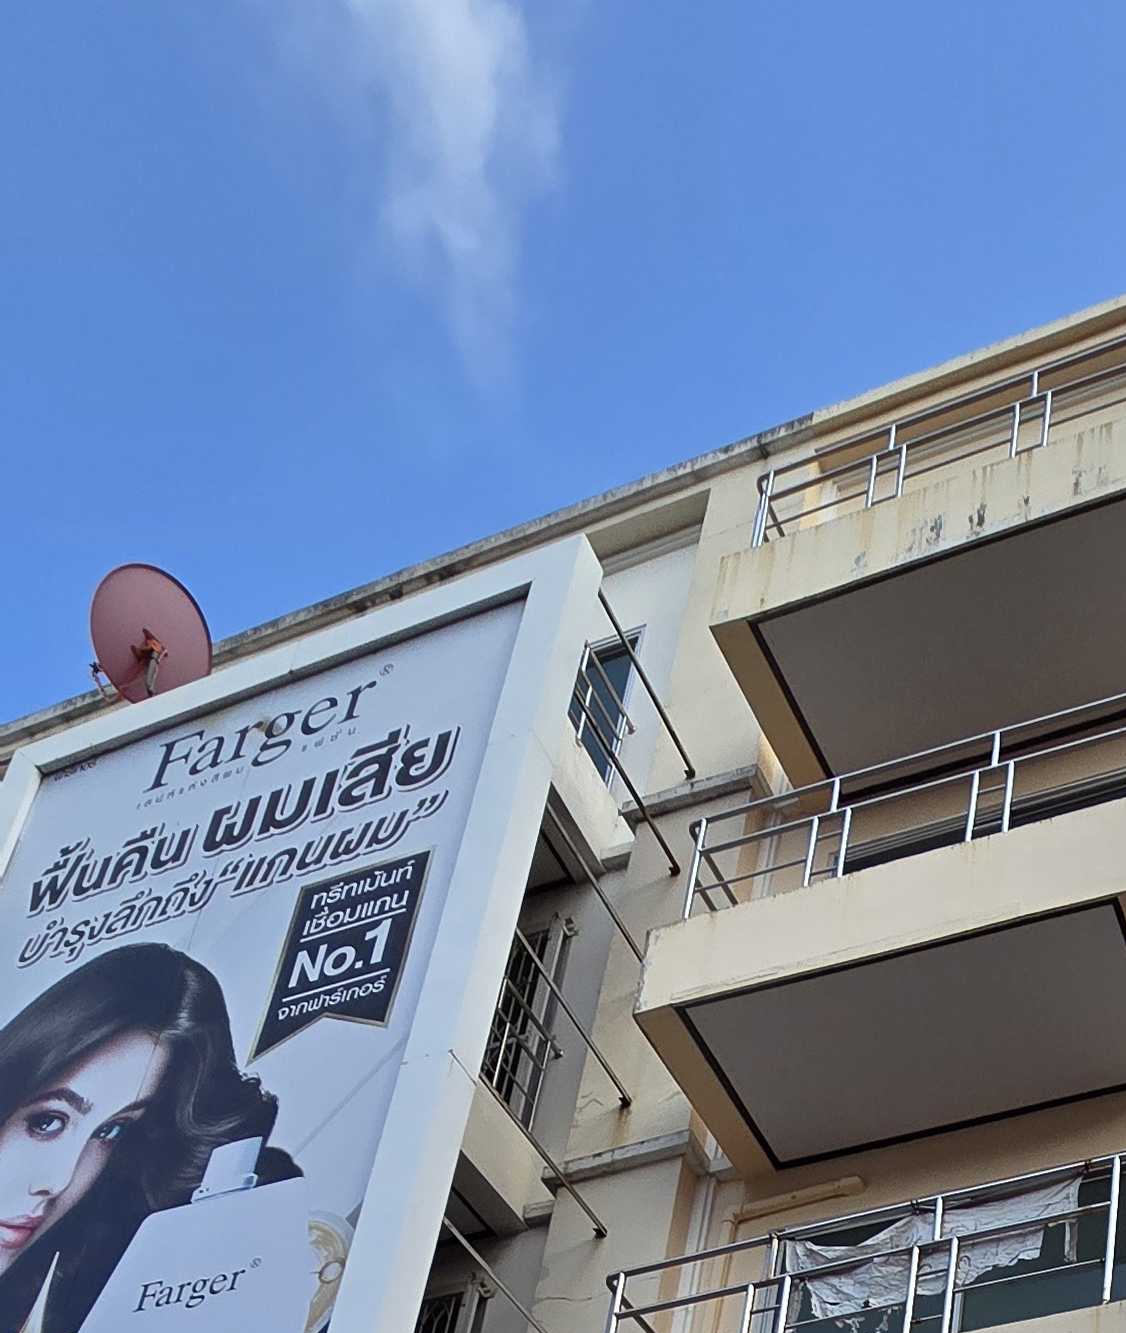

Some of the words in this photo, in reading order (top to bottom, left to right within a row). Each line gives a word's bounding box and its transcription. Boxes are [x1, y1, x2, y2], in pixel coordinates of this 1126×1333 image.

[142, 680, 378, 794] Farger
[27, 822, 199, 918] ฟื้นคืน
[202, 725, 461, 858] ผมเสีย
[310, 859, 416, 911] ทรีทเม้นท์
[302, 890, 410, 936] เชื่อมแกน
[288, 917, 394, 989] No.1
[277, 975, 388, 1021] จากฟาร์เกอร์
[133, 1268, 246, 1313] Farger
